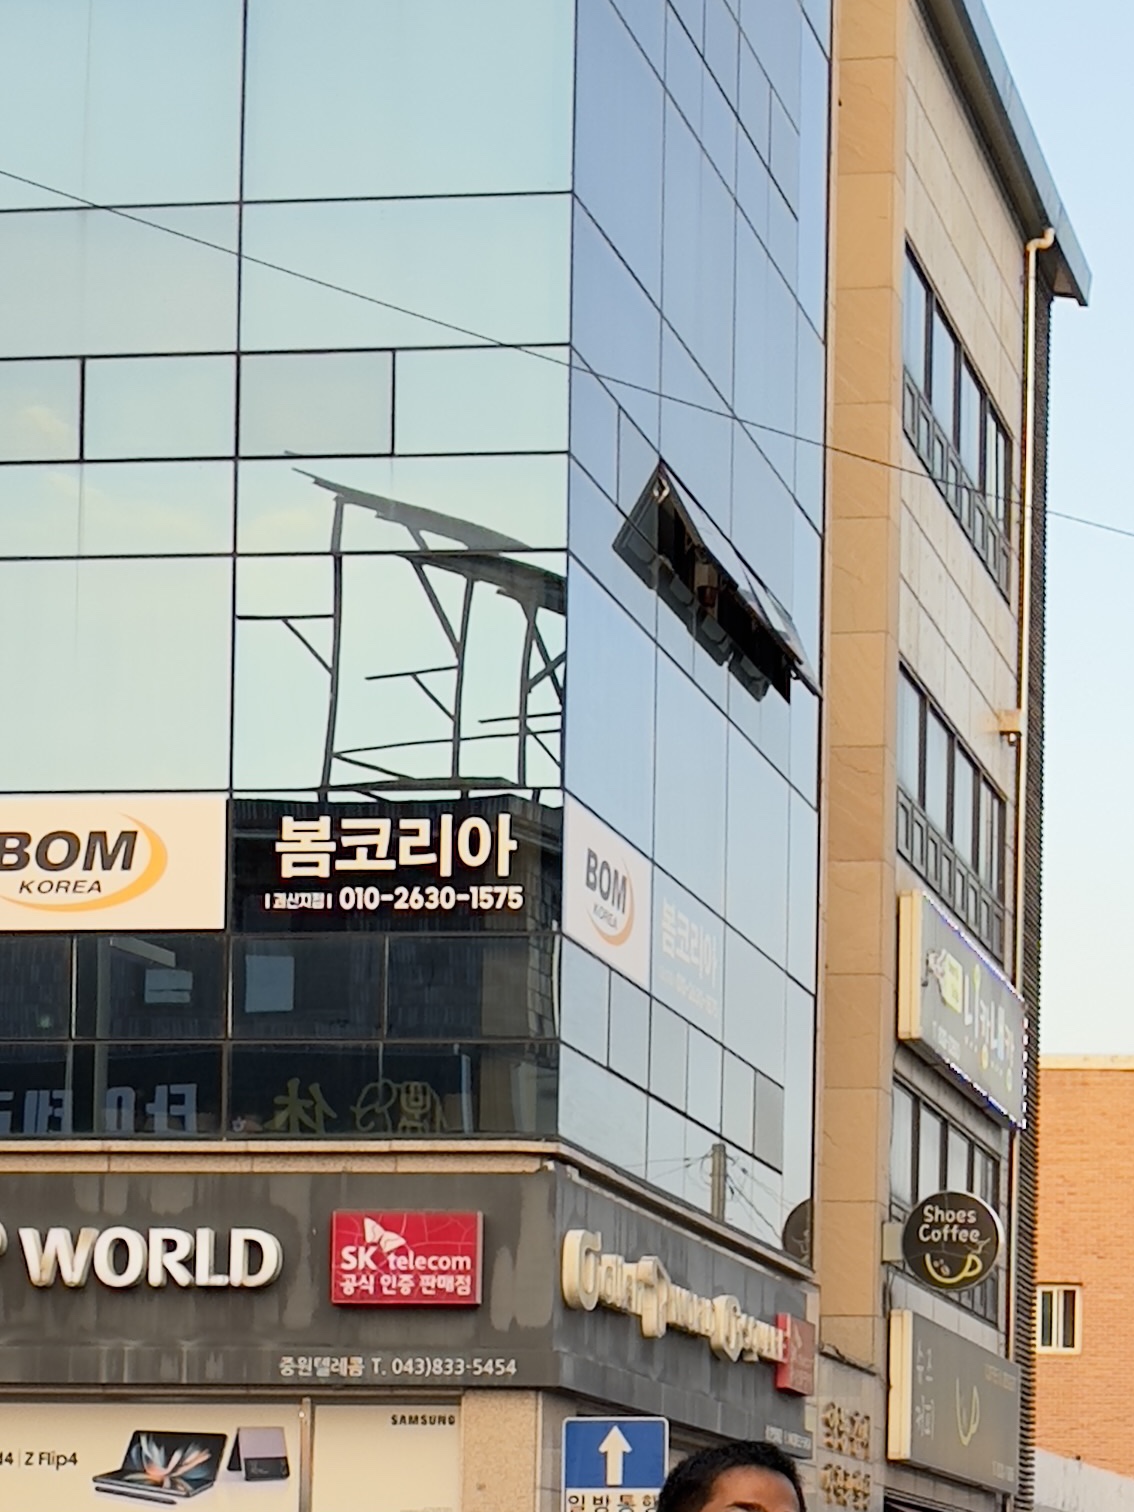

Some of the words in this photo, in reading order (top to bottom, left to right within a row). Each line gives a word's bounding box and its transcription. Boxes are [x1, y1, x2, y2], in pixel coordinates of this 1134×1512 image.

[0, 831, 138, 872] BOM
[275, 813, 518, 878] 봄코리아
[19, 880, 102, 894] KOREA
[586, 848, 627, 914] BOM
[339, 886, 523, 910] 010-2630-1575
[661, 896, 717, 988] 봄코리아
[922, 1204, 977, 1224] Shoes
[918, 1223, 981, 1243] Coffee
[18, 1226, 283, 1287] WORLD
[341, 1246, 378, 1270] SK
[387, 1250, 472, 1271] telecom
[340, 1274, 375, 1296] 공식
[380, 1274, 415, 1296] 인증
[419, 1274, 472, 1296] 판매점
[371, 1357, 388, 1376] T.
[391, 1357, 517, 1377] 043)833-5454
[391, 1414, 456, 1426] SAMSUNG
[24, 1451, 34, 1466] Z
[38, 1450, 78, 1471] Flip4
